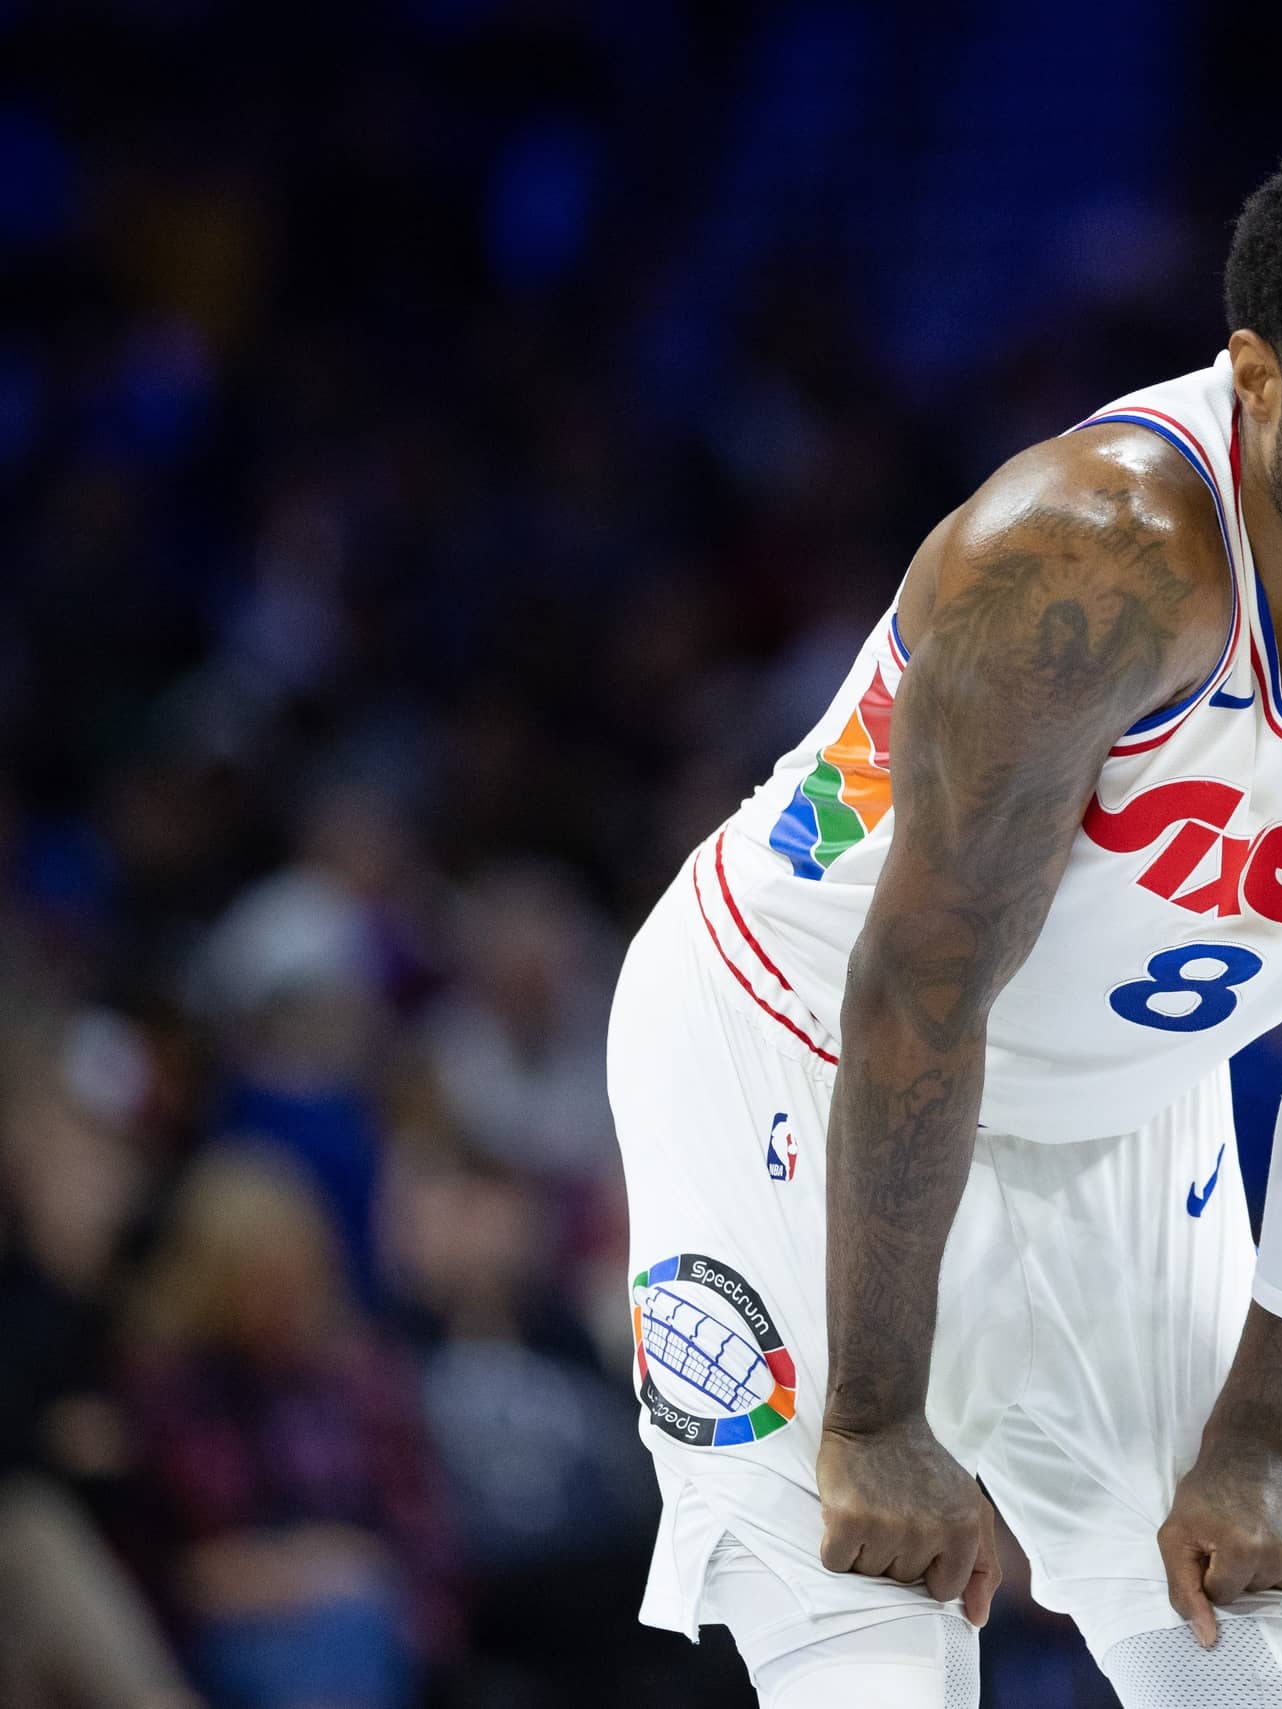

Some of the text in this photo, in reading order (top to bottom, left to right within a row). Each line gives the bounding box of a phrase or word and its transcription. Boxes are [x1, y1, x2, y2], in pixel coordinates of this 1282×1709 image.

[1109, 943, 1263, 1032] 8
[769, 1163, 784, 1177] NBA
[691, 1260, 769, 1335] Spectrum
